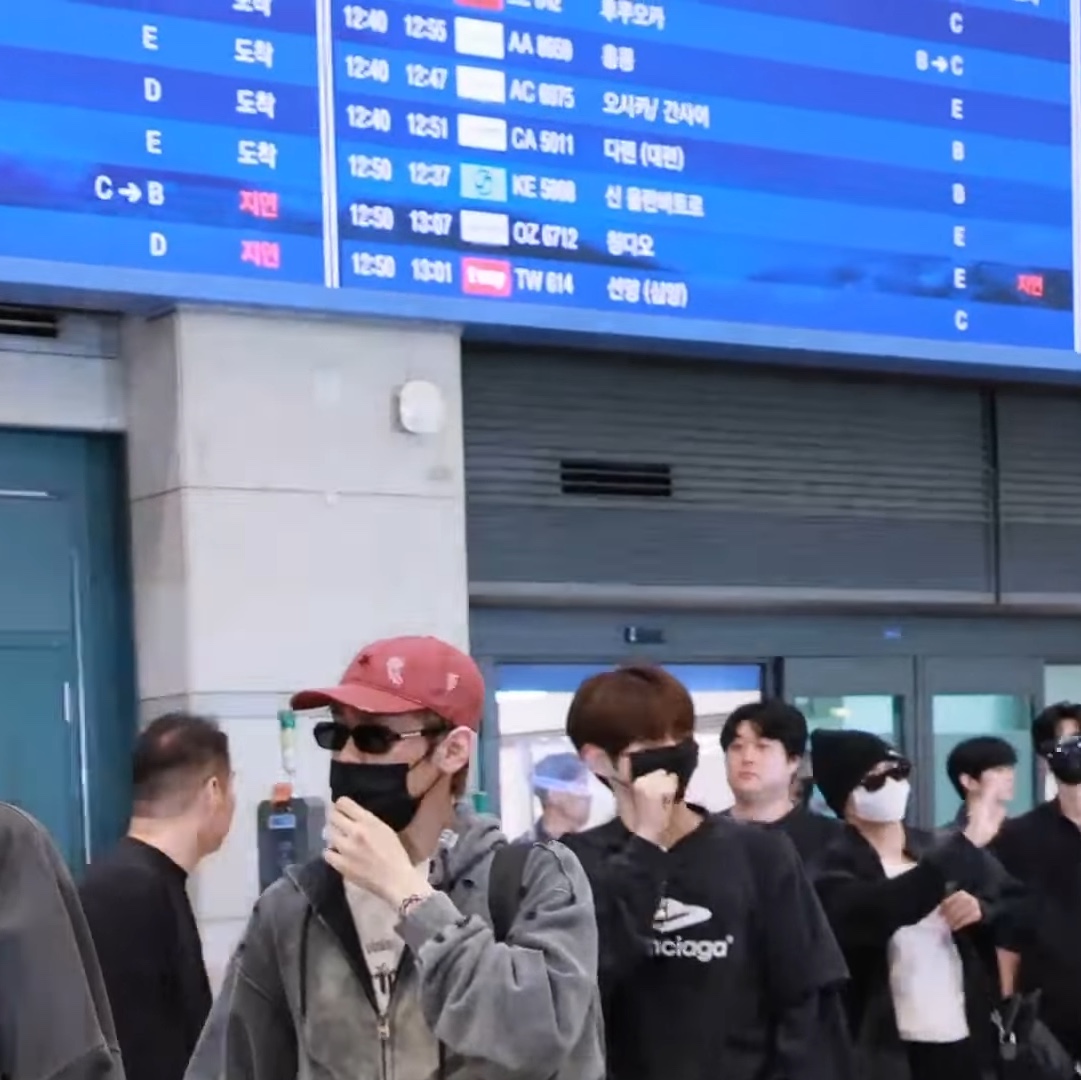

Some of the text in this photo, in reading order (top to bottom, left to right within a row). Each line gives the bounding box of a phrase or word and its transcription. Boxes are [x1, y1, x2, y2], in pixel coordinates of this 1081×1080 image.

[142, 25, 158, 50] E
[144, 77, 162, 102] D
[951, 98, 963, 119] E
[146, 130, 162, 154] E
[94, 175, 113, 200] C
[148, 181, 165, 205] B
[150, 232, 167, 256] D
[954, 226, 965, 246] E
[954, 268, 966, 289] E
[514, 267, 544, 291] TW
[955, 310, 968, 330] C
